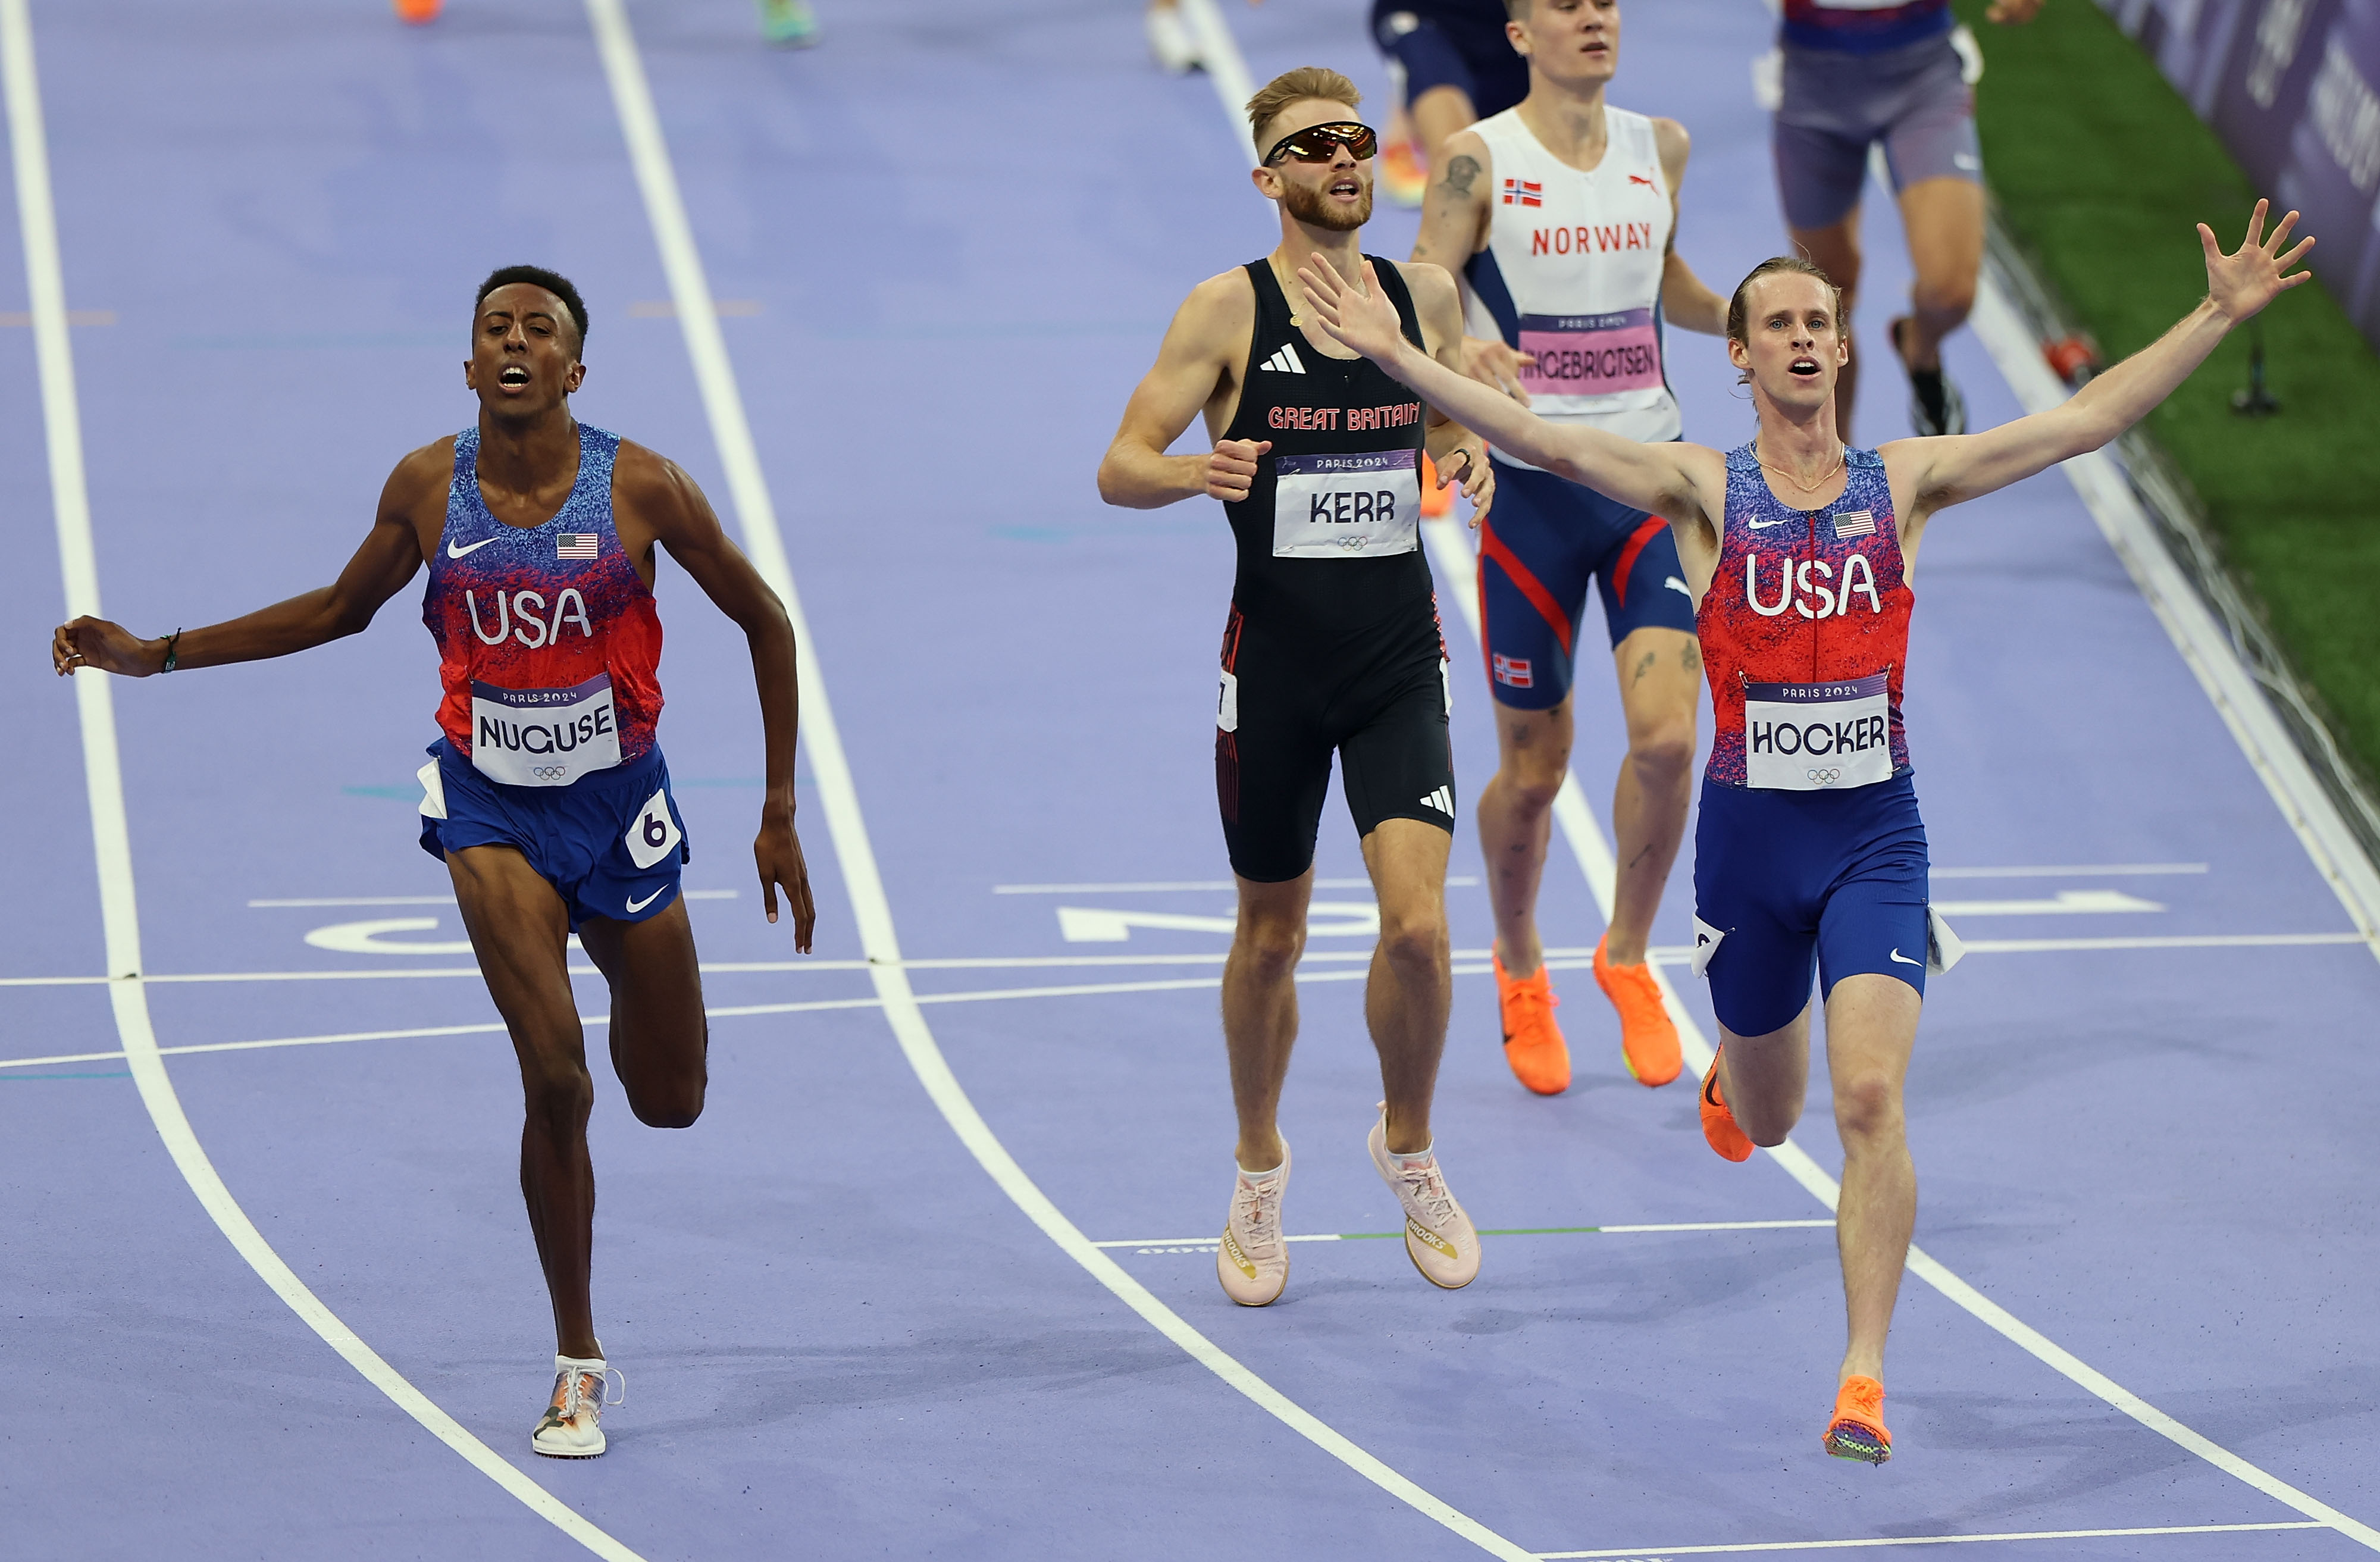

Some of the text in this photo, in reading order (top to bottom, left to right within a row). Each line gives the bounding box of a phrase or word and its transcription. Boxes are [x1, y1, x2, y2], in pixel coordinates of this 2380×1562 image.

[1532, 223, 1651, 256] NORWAY
[1268, 402, 1421, 431] GREAT BRITAIN
[1317, 457, 1388, 468] PARIS 2024
[1310, 490, 1395, 524] KERR
[1747, 553, 1881, 619] USA
[466, 589, 592, 649] USA
[503, 691, 577, 703] PARIS 2024
[1782, 686, 1858, 698] PARIS 2024
[480, 704, 613, 754] NUGUSE
[1753, 715, 1886, 755] HOCKER
[643, 812, 666, 847] 6
[1408, 1219, 1446, 1249] BROOKS
